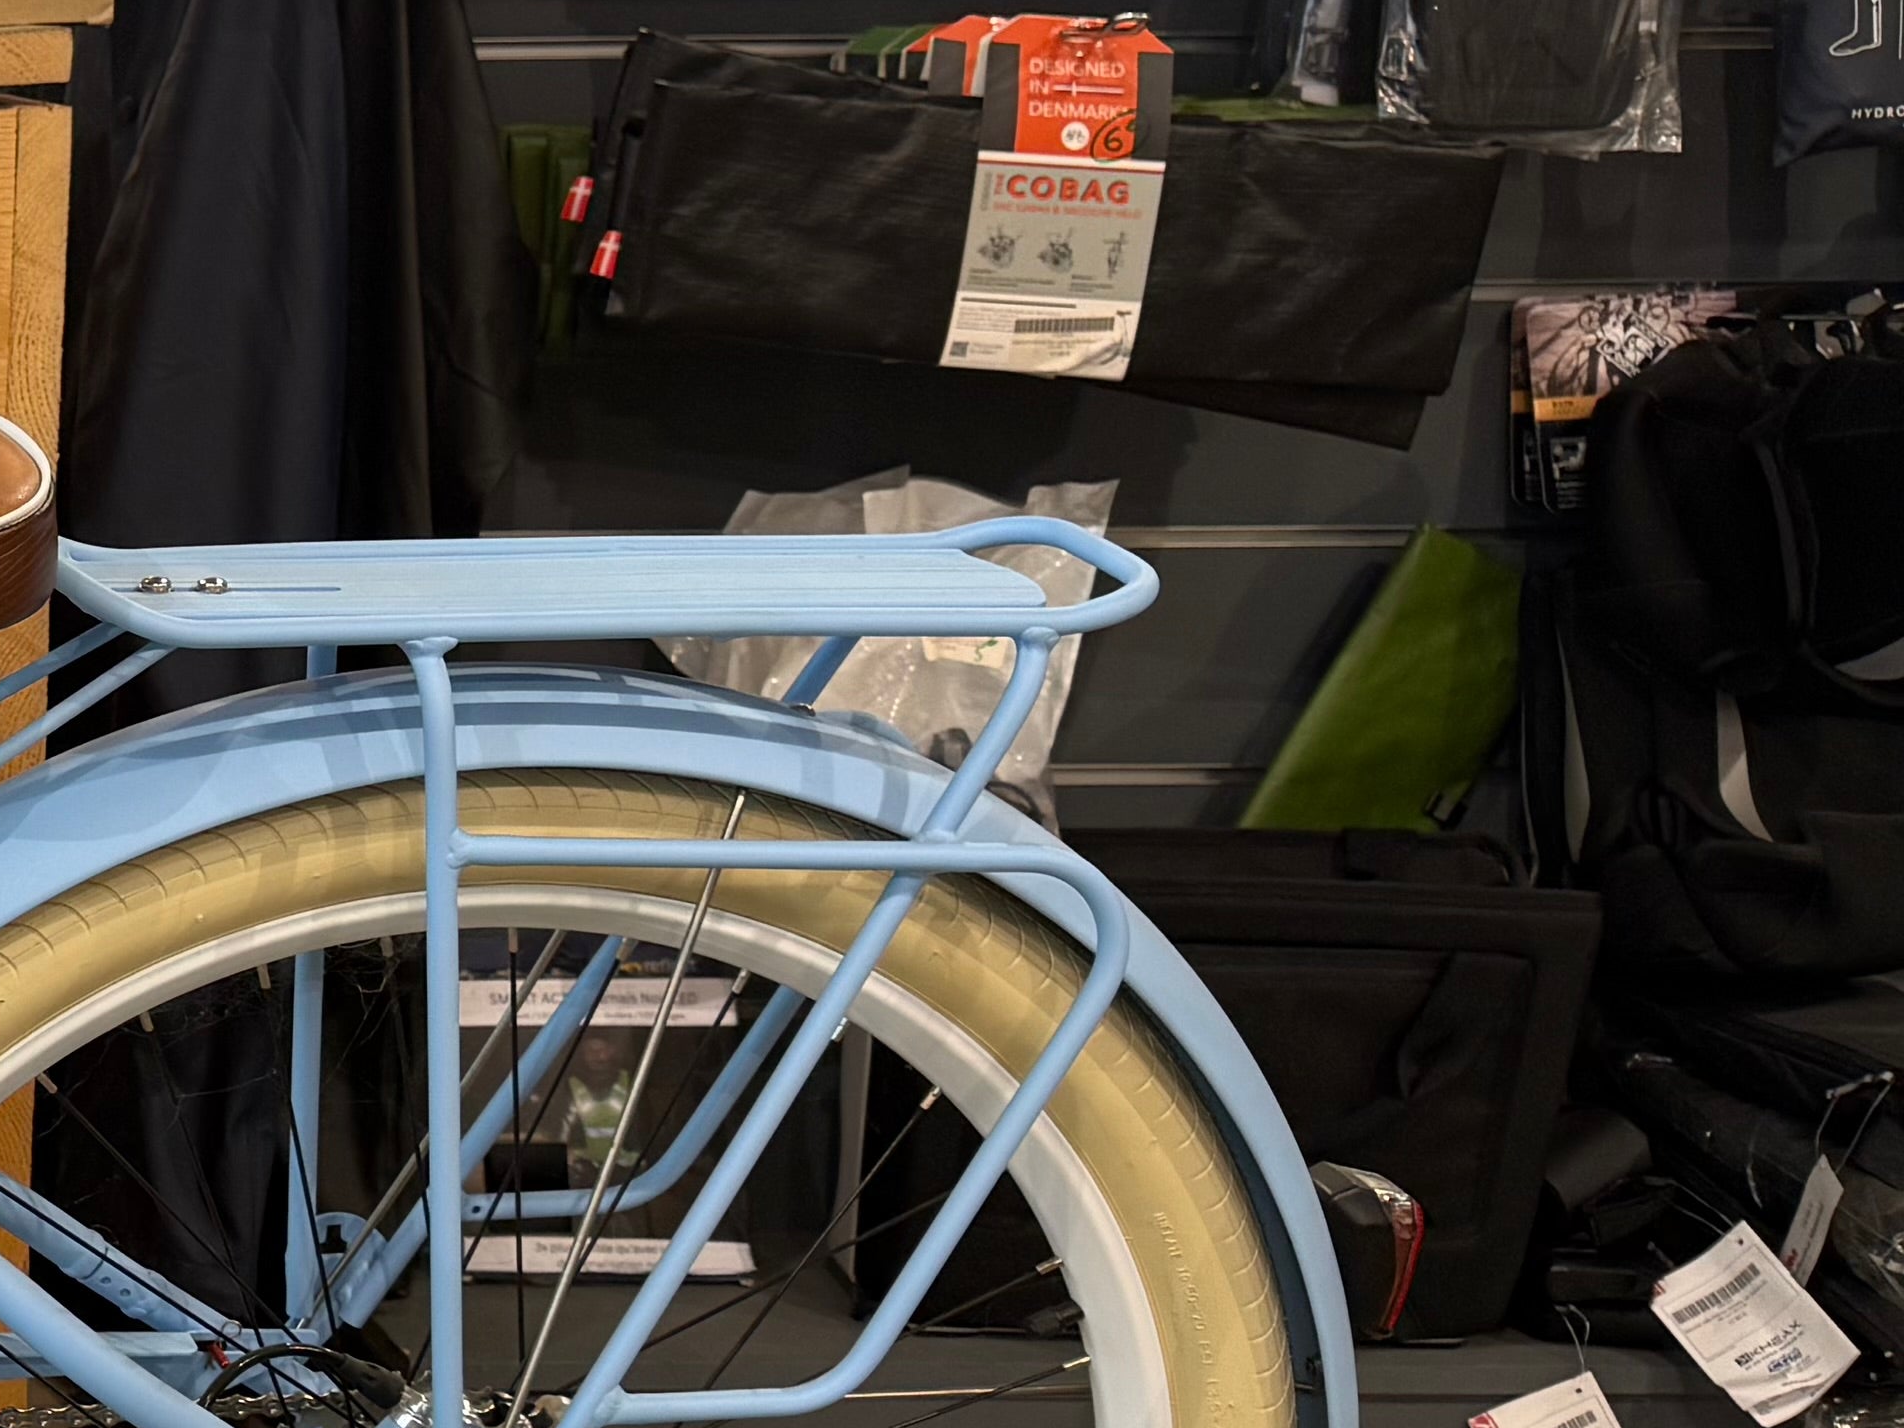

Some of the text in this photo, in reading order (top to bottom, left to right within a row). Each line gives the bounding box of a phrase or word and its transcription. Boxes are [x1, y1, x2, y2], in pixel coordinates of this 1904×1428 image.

[1029, 57, 1126, 78] DESIGNED
[1030, 80, 1049, 94] IN
[1006, 175, 1130, 204] COBAG
